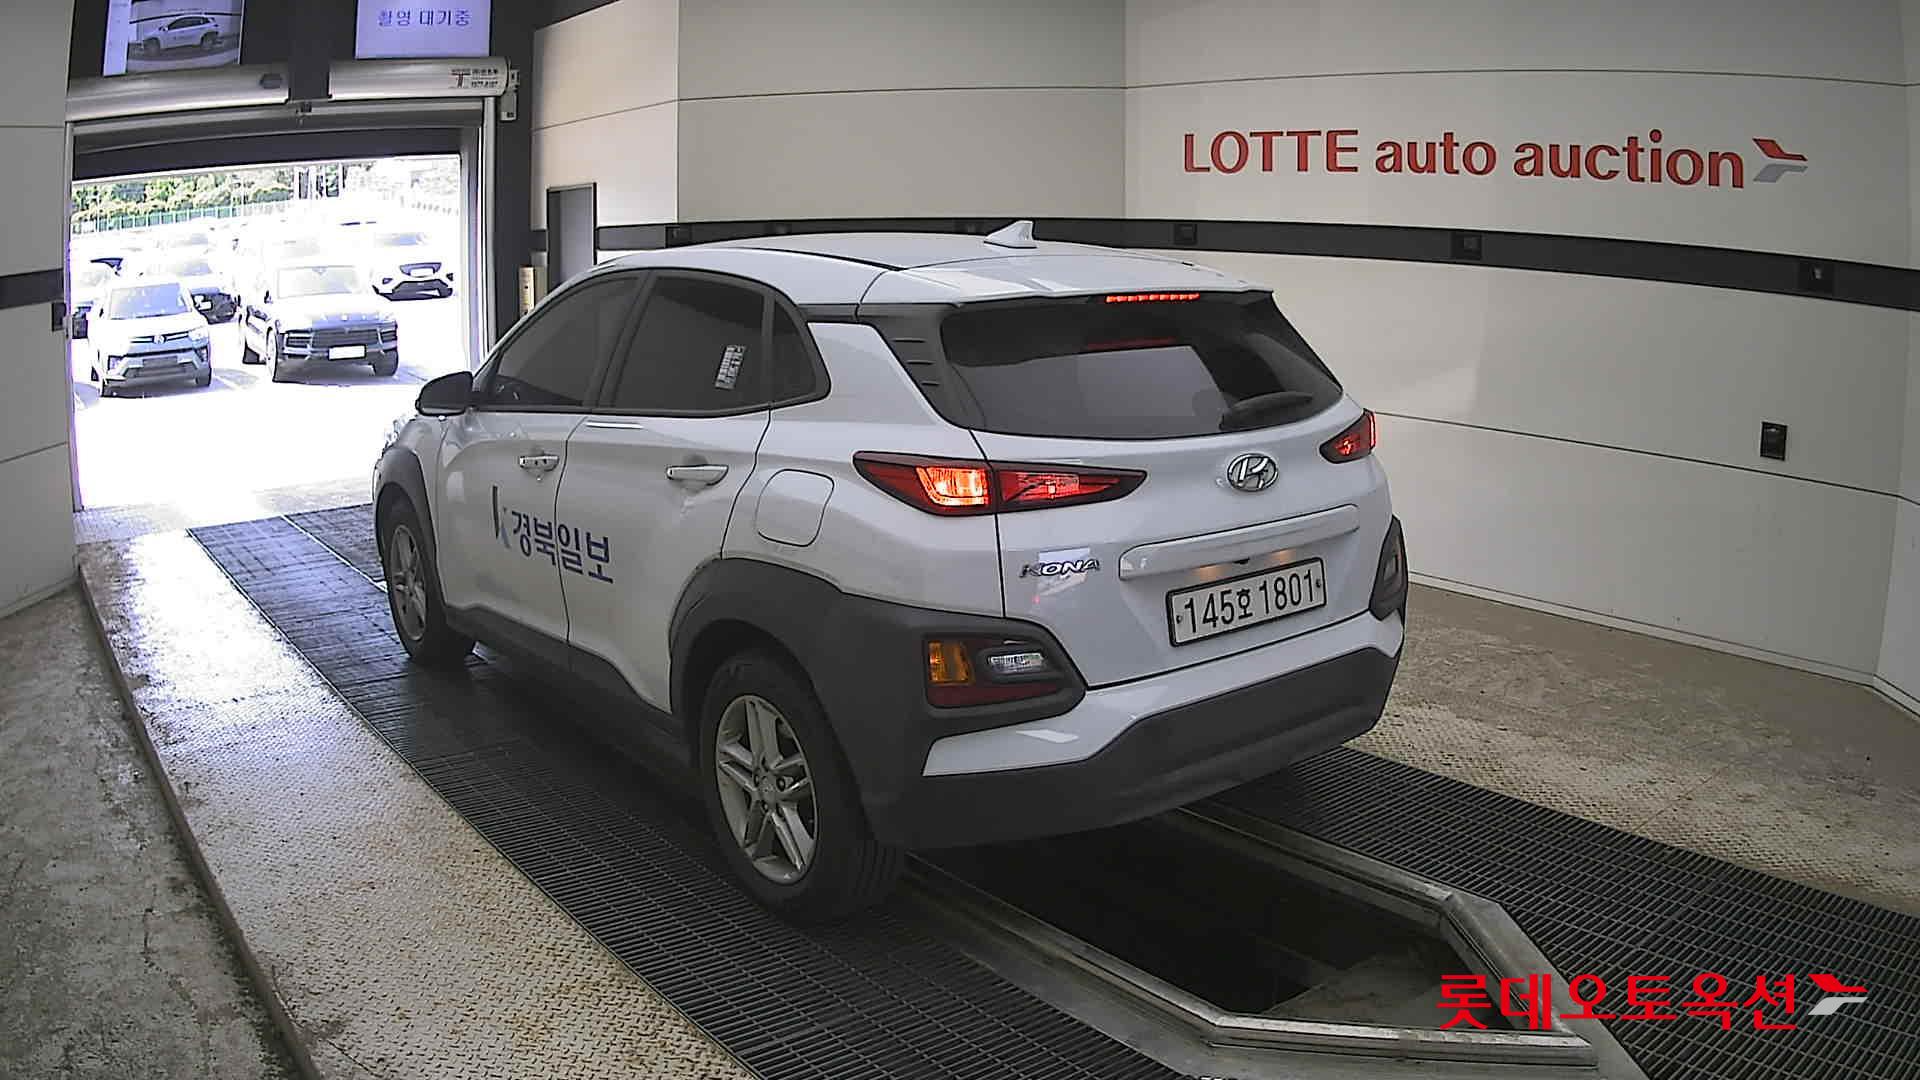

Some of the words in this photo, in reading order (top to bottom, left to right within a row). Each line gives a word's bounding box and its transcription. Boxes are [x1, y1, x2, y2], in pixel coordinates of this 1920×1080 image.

[419, 9, 471, 27] 대기중
[1184, 129, 1359, 174] LOTTE
[1375, 132, 1497, 175] auto
[1513, 129, 1744, 188] auction
[511, 510, 614, 584] 경북일보
[1019, 558, 1100, 578] KONA
[1184, 588, 1253, 633] 145호
[1258, 569, 1315, 616] 1801
